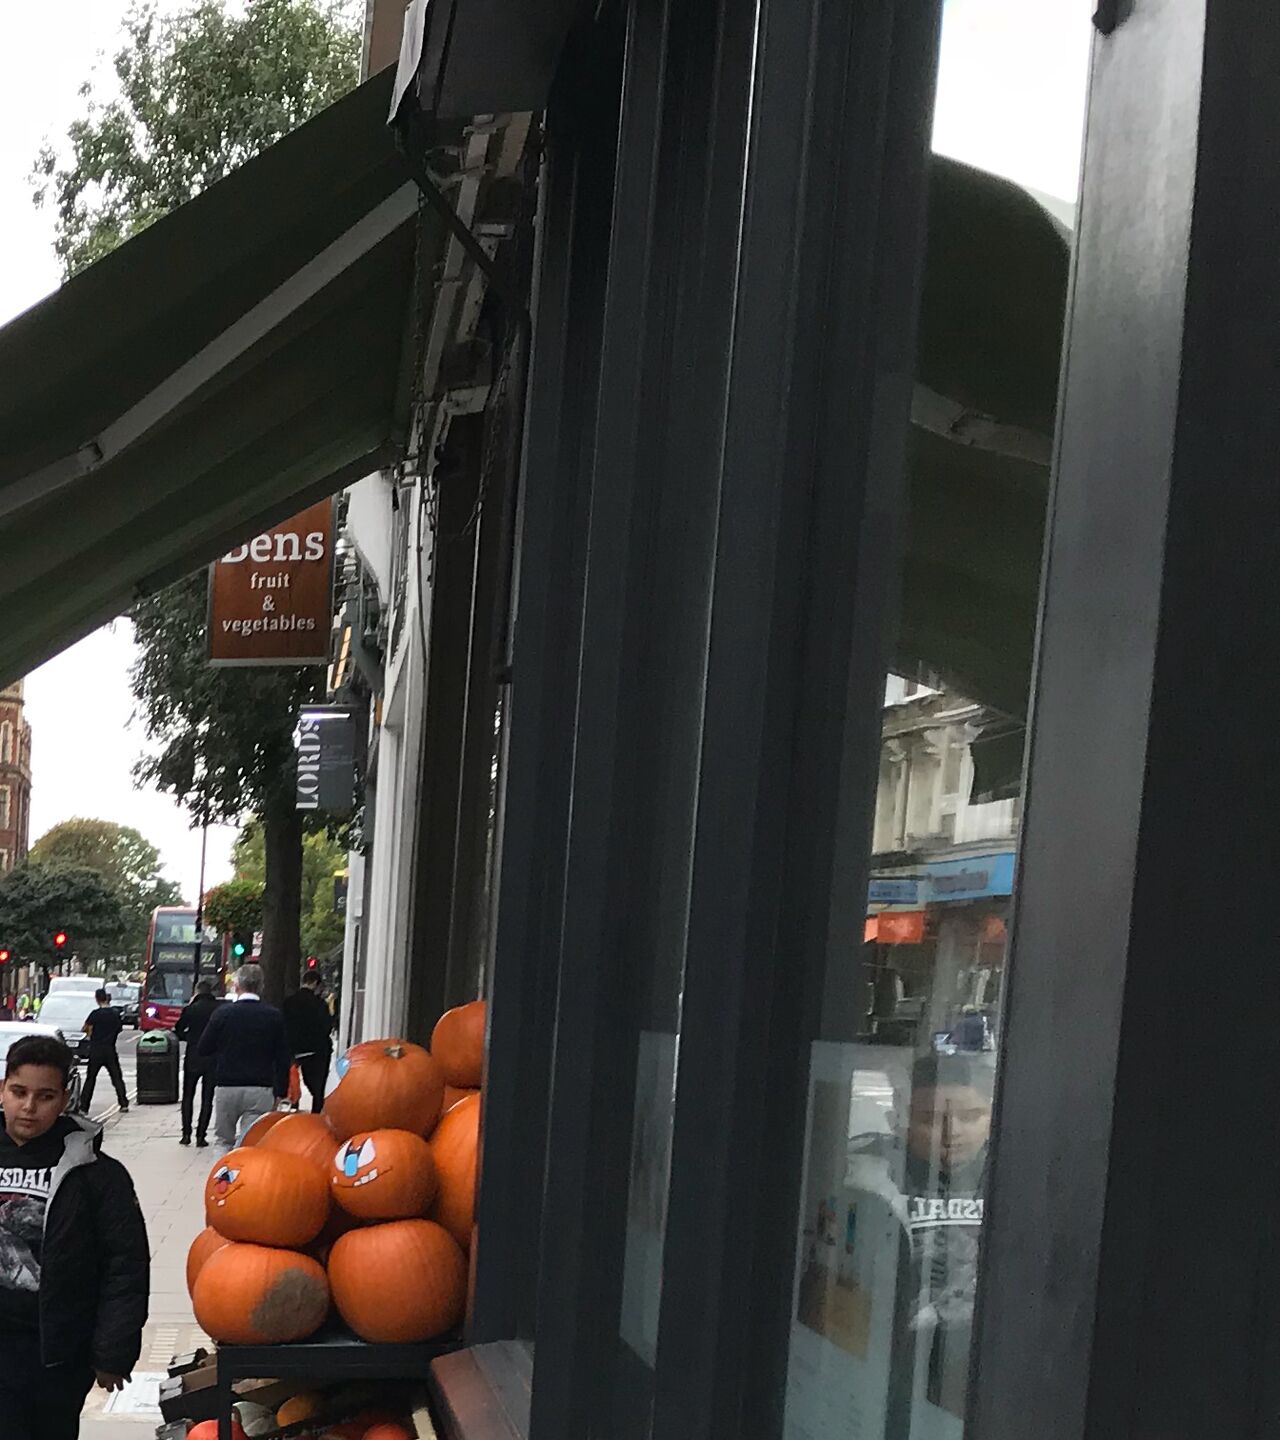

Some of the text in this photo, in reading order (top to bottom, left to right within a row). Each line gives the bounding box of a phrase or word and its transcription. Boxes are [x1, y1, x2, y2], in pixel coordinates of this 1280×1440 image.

[250, 572, 290, 589] fruit
[262, 594, 275, 611] &
[222, 614, 316, 636] vegetables
[296, 718, 320, 809] LORDS
